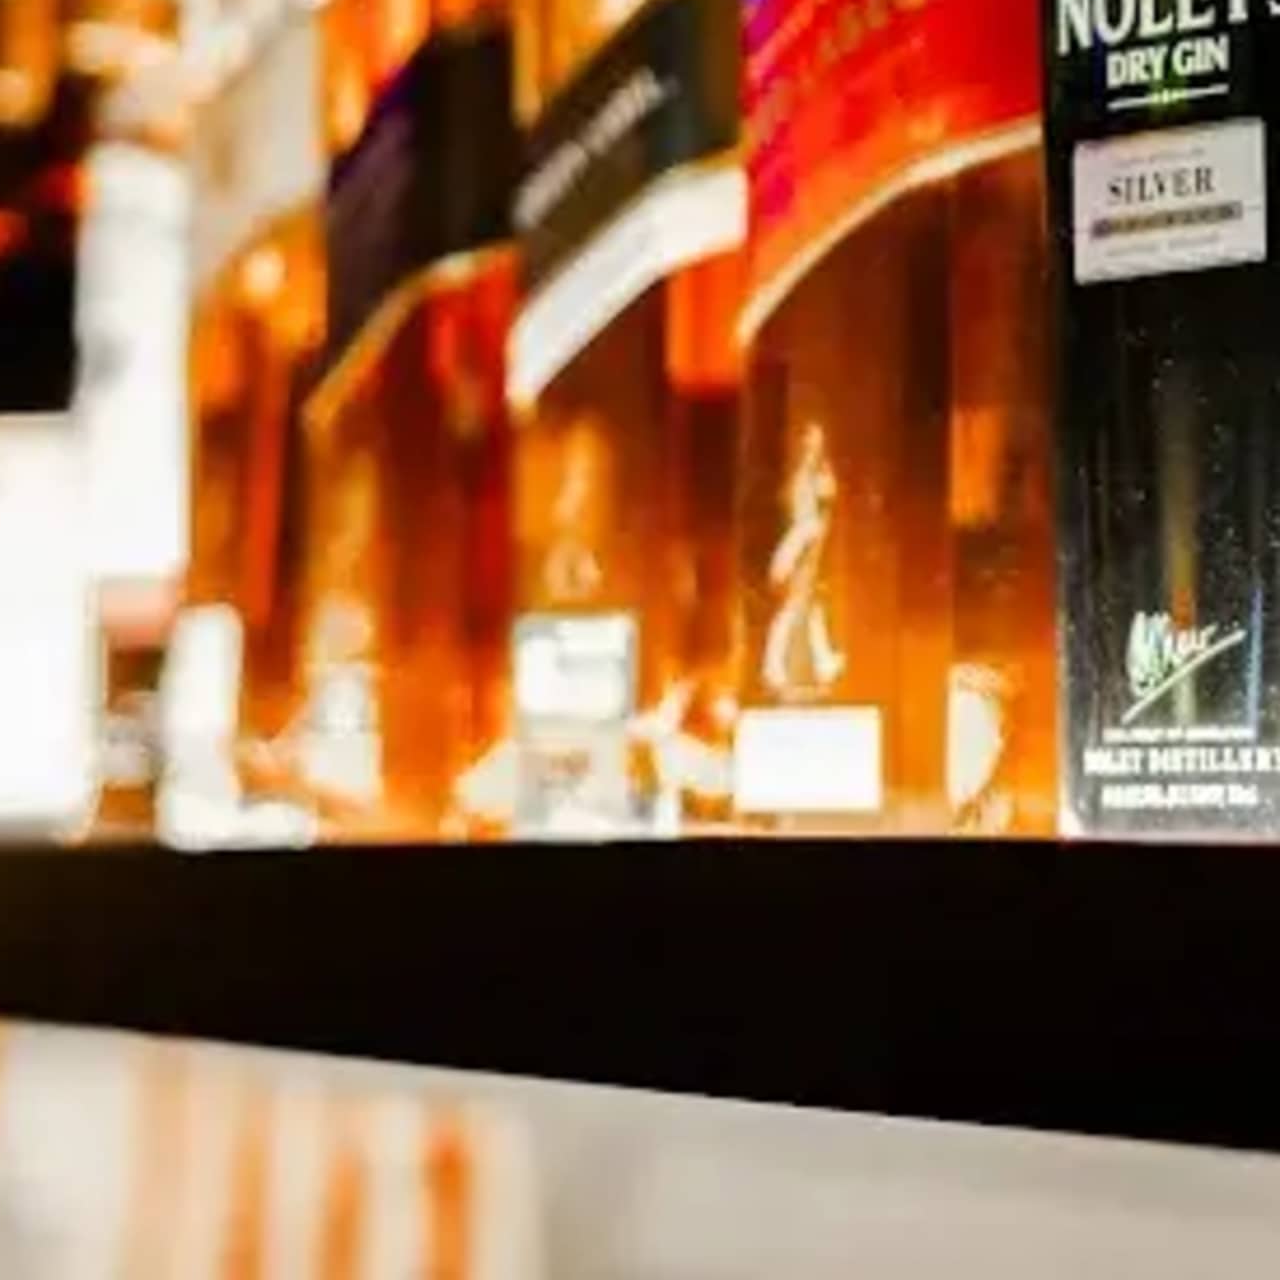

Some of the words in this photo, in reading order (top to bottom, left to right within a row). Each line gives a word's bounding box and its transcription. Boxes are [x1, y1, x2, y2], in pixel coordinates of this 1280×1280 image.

[1106, 42, 1167, 88] DRY
[1171, 34, 1230, 74] GIN
[1106, 166, 1217, 207] SILVER
